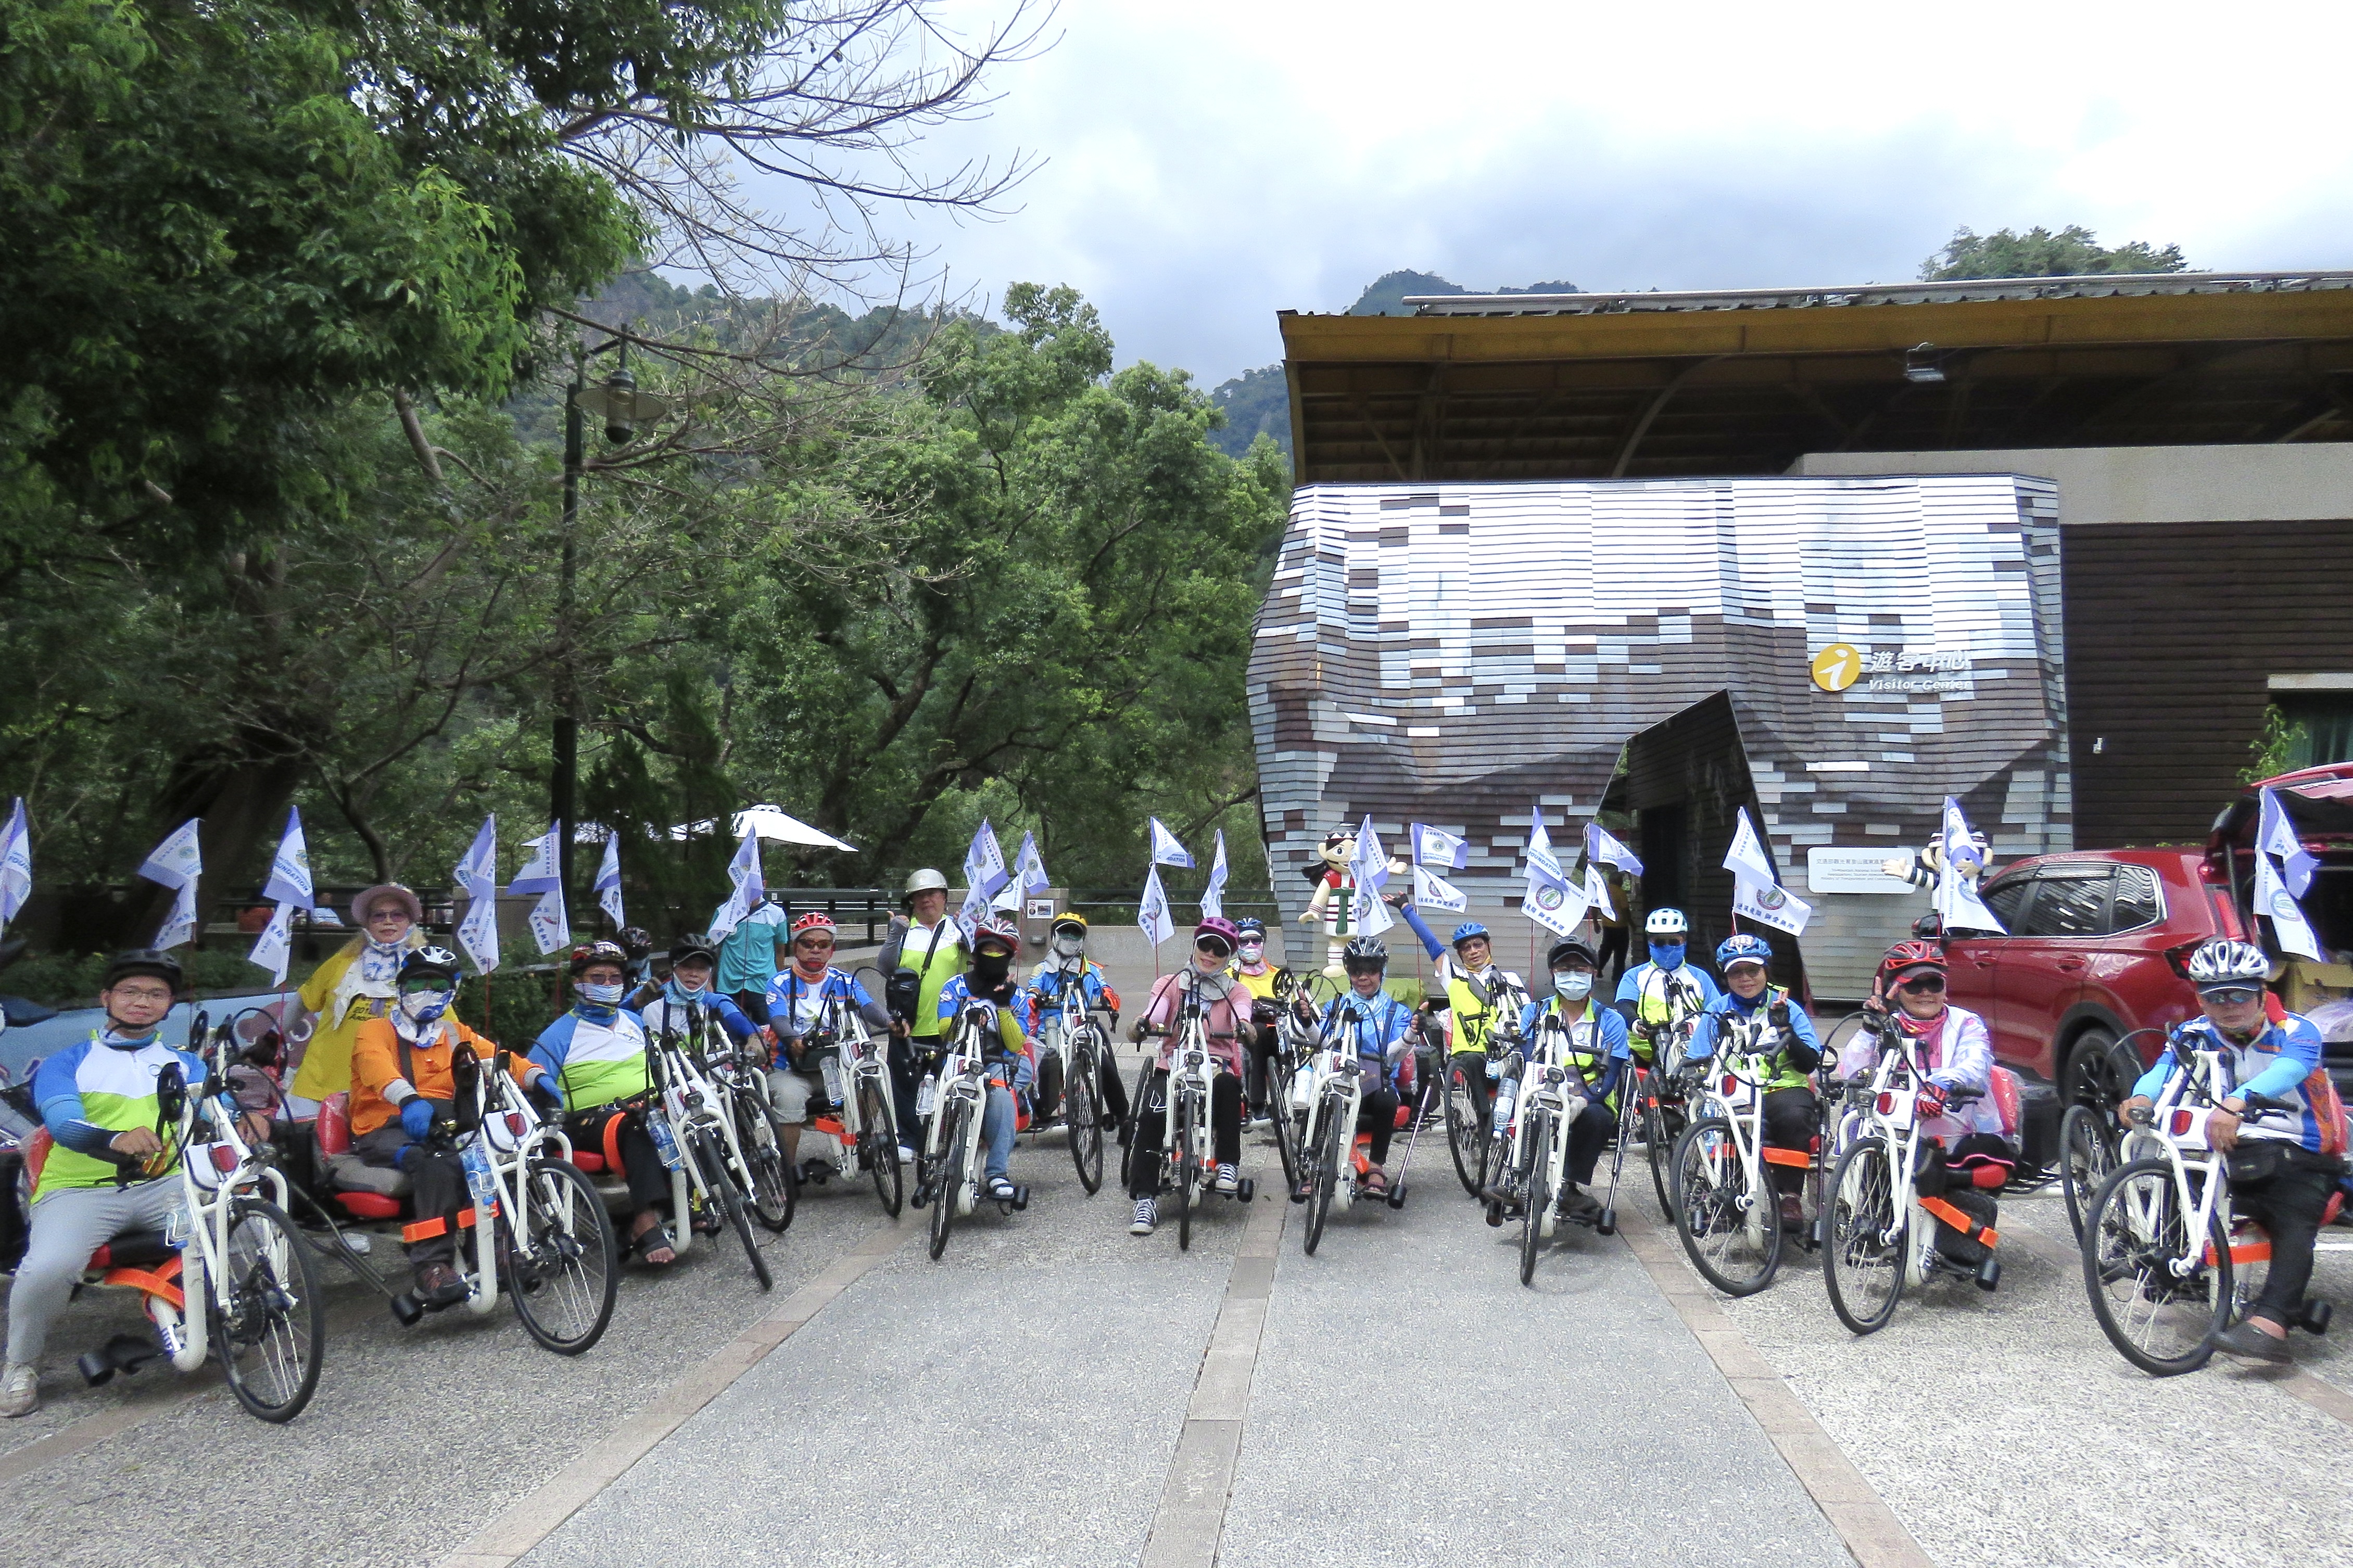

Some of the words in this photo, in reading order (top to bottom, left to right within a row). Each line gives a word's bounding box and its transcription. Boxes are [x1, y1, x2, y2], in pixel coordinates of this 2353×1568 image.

[1868, 650, 1969, 672] 遊客中心
[1869, 679, 1916, 691] Visitor
[1922, 679, 1972, 691] Center
[1528, 851, 1561, 875] FOUNDATION
